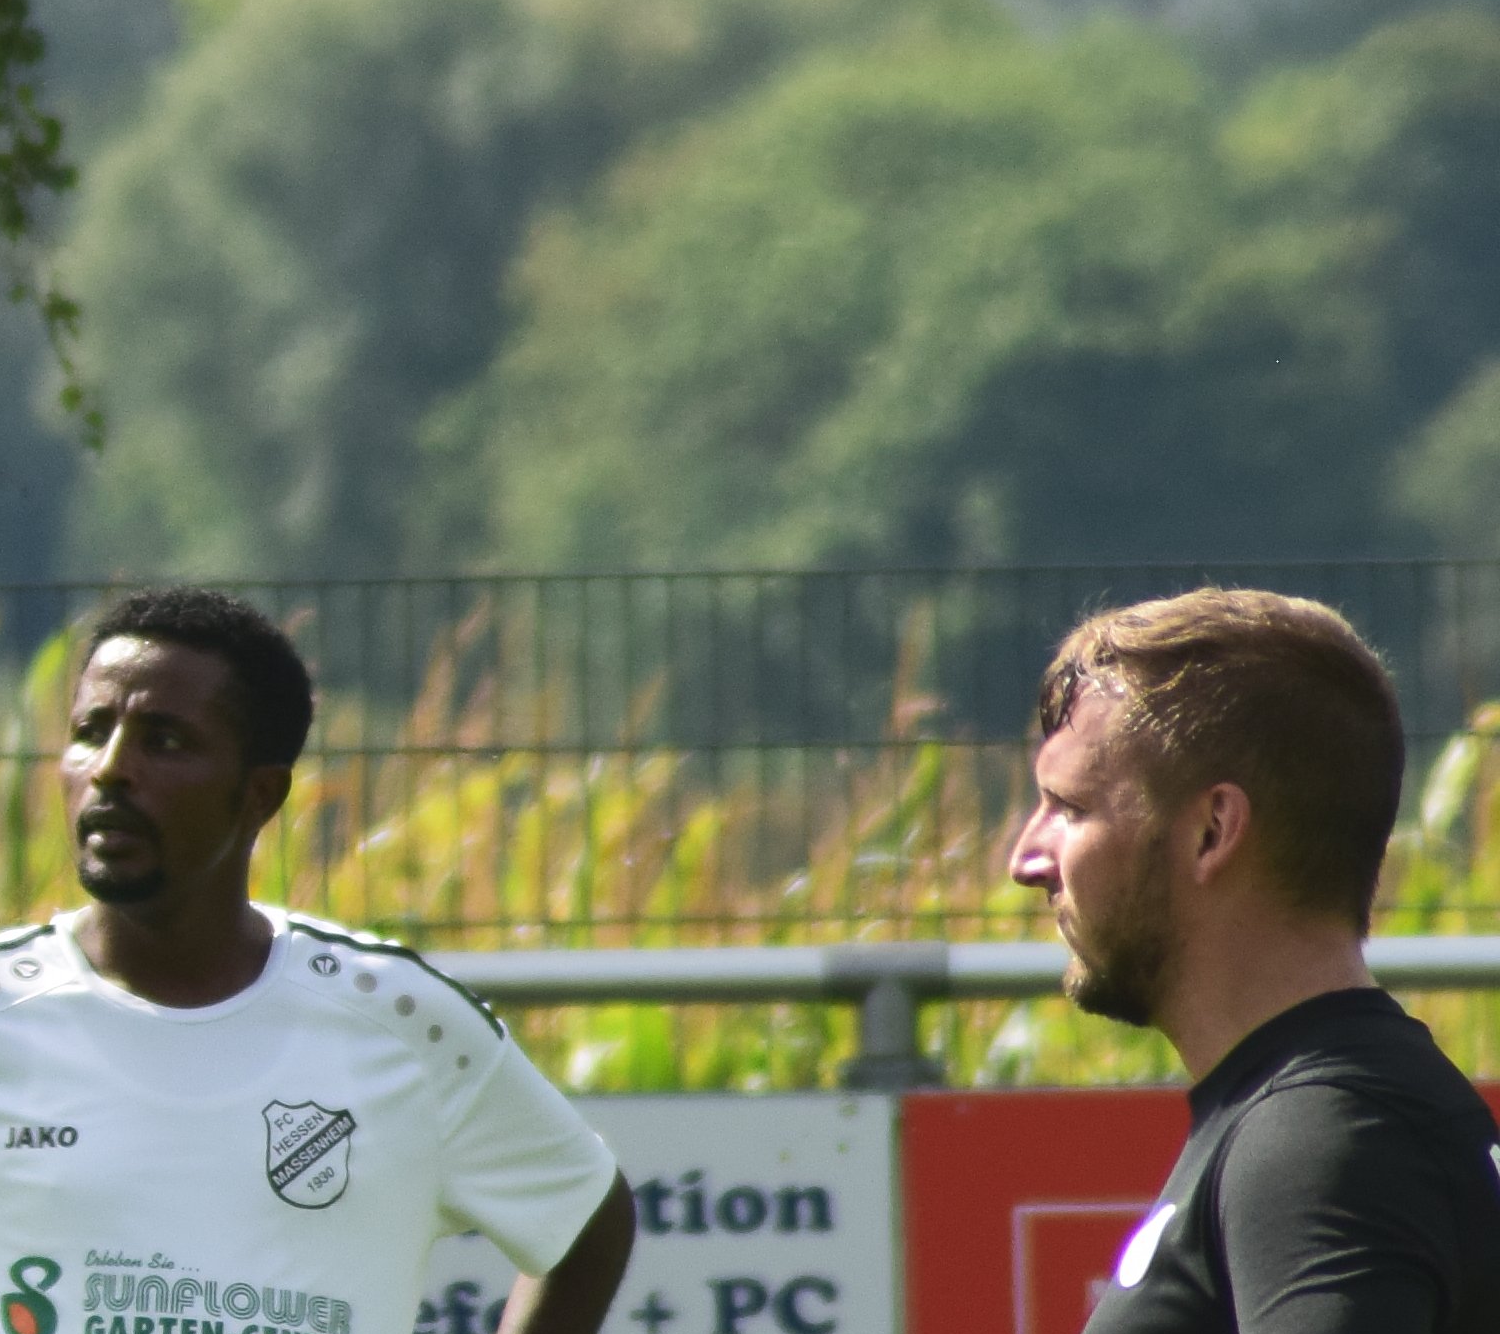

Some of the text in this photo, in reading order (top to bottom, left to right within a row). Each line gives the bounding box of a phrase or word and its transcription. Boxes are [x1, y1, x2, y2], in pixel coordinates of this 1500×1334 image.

[272, 1112, 325, 1156] HESSEN
[274, 1112, 295, 1132] FC
[5, 1126, 78, 1149] JAKO
[271, 1116, 352, 1186] MASSENHEIM
[307, 1166, 335, 1192] 1930
[148, 1252, 175, 1269] Sie
